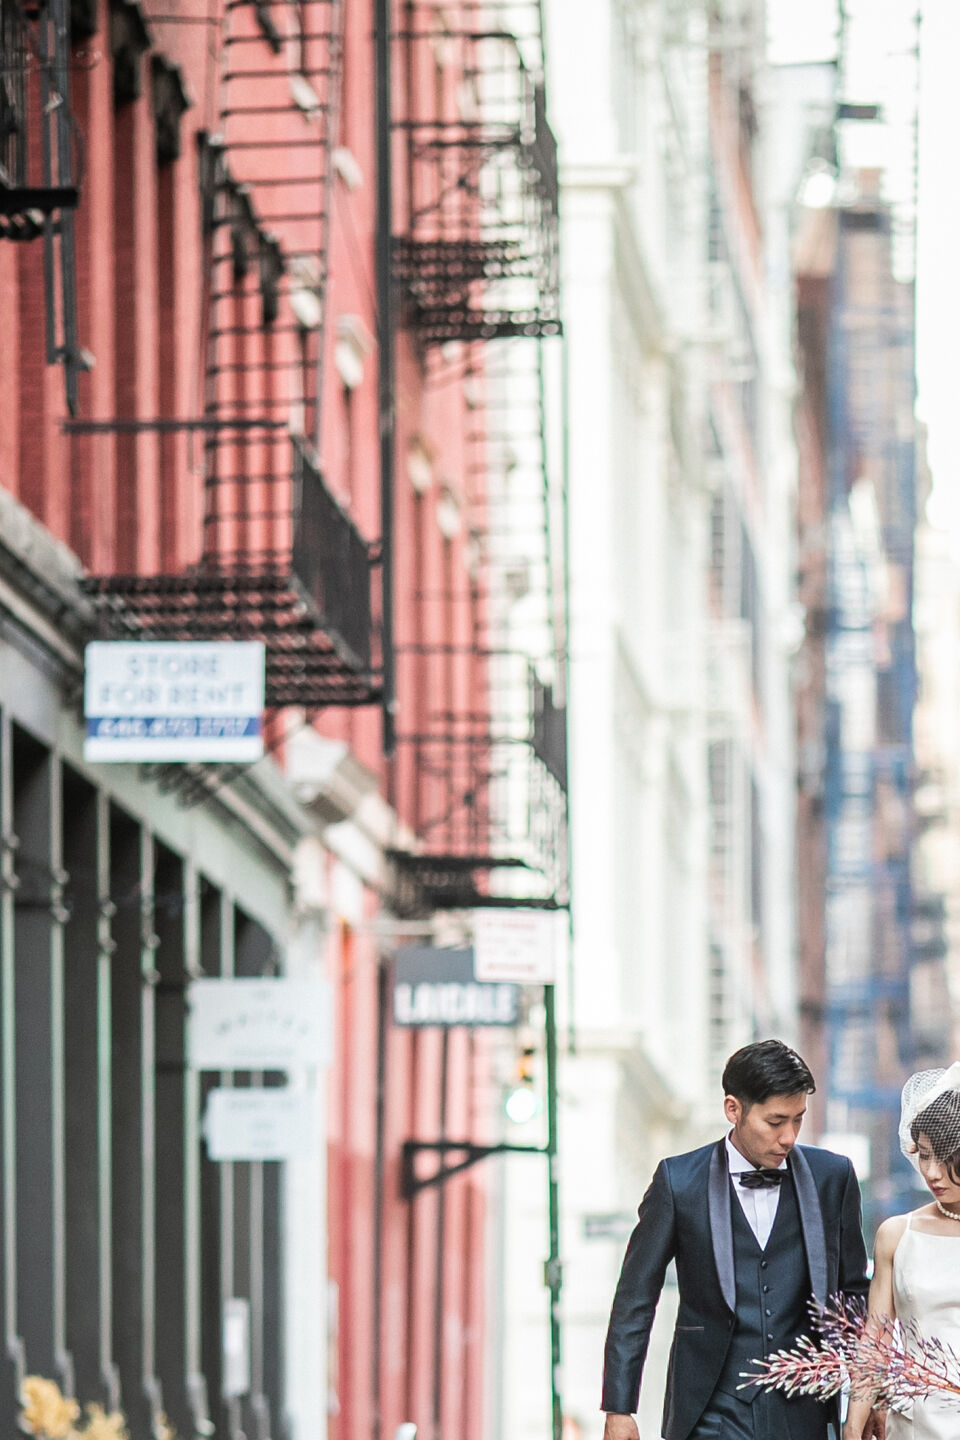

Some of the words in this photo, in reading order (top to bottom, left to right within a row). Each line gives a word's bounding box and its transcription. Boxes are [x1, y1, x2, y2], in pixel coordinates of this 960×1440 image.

[126, 653, 221, 679] STORE
[101, 681, 158, 706] FOR
[168, 681, 247, 706] RENT
